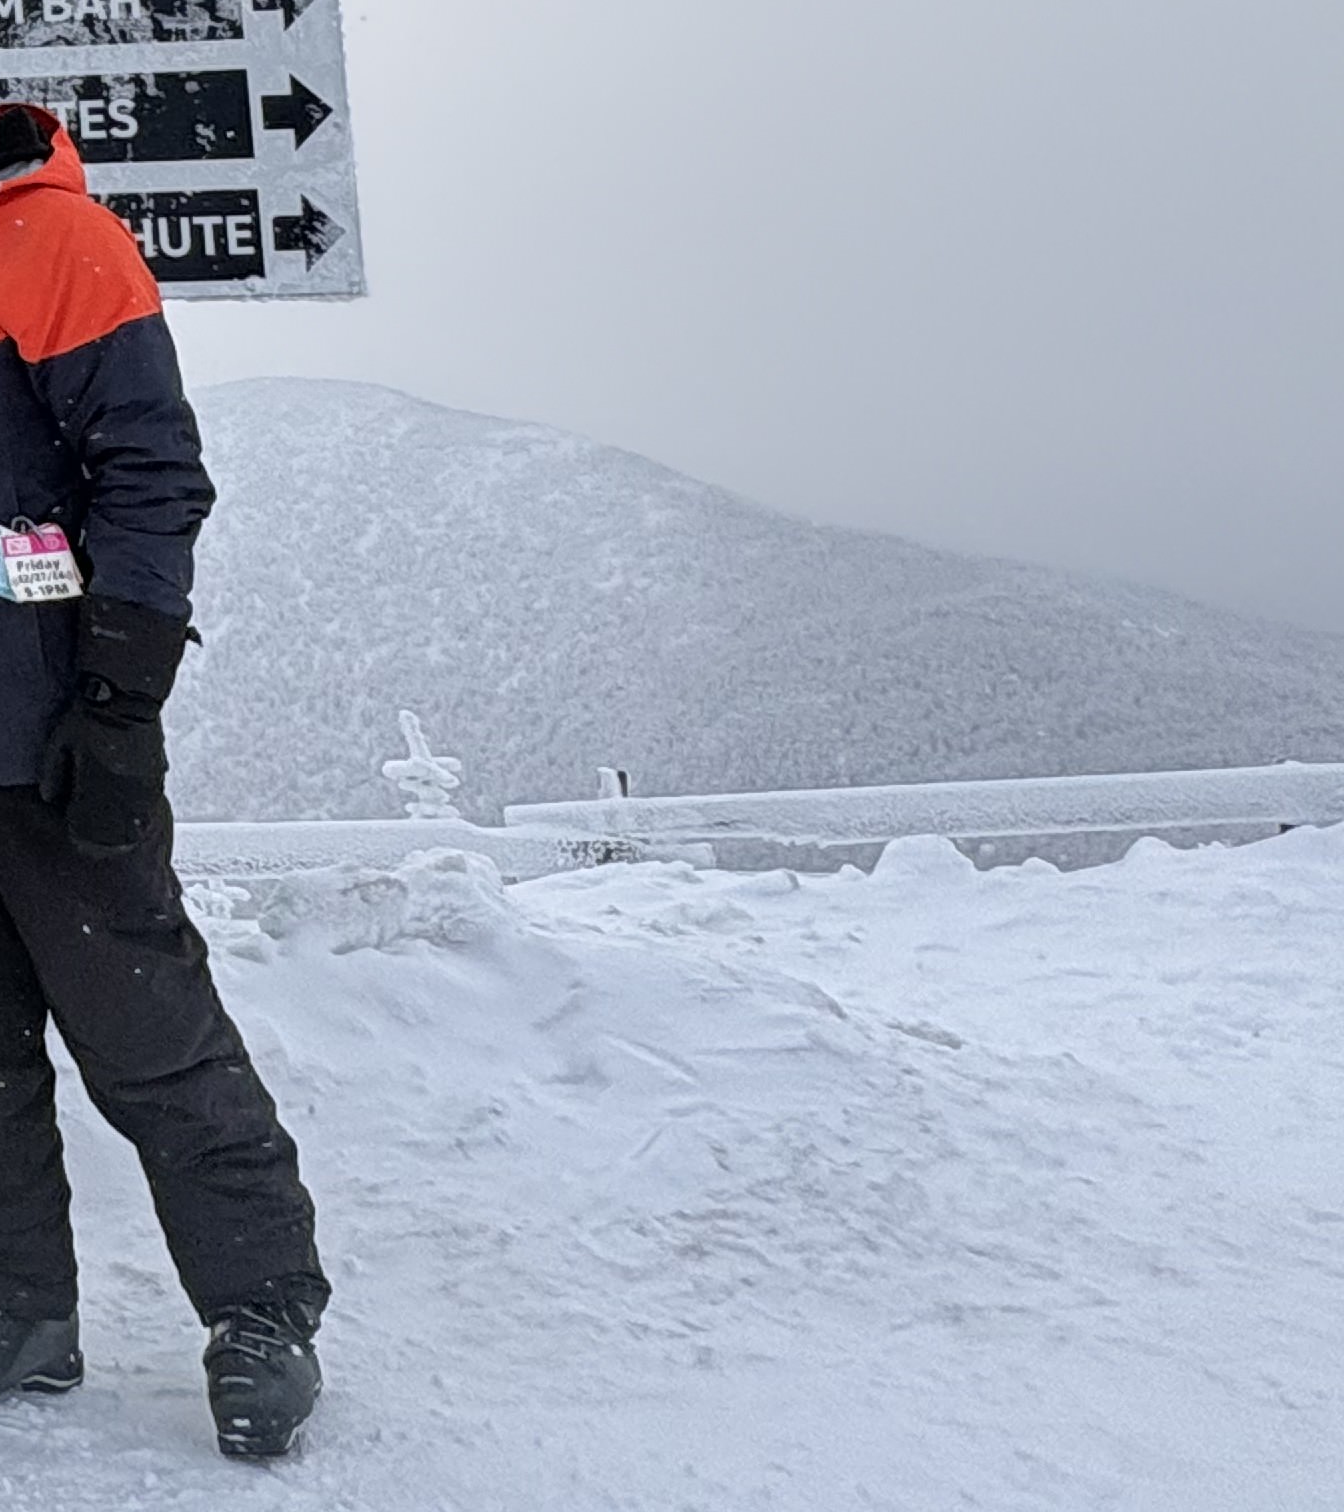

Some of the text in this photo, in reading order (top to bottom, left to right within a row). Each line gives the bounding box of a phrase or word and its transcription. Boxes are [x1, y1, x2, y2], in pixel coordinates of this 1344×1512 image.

[45, 98, 139, 140] TES
[122, 214, 256, 258] HUTE
[16, 559, 60, 573] Friday
